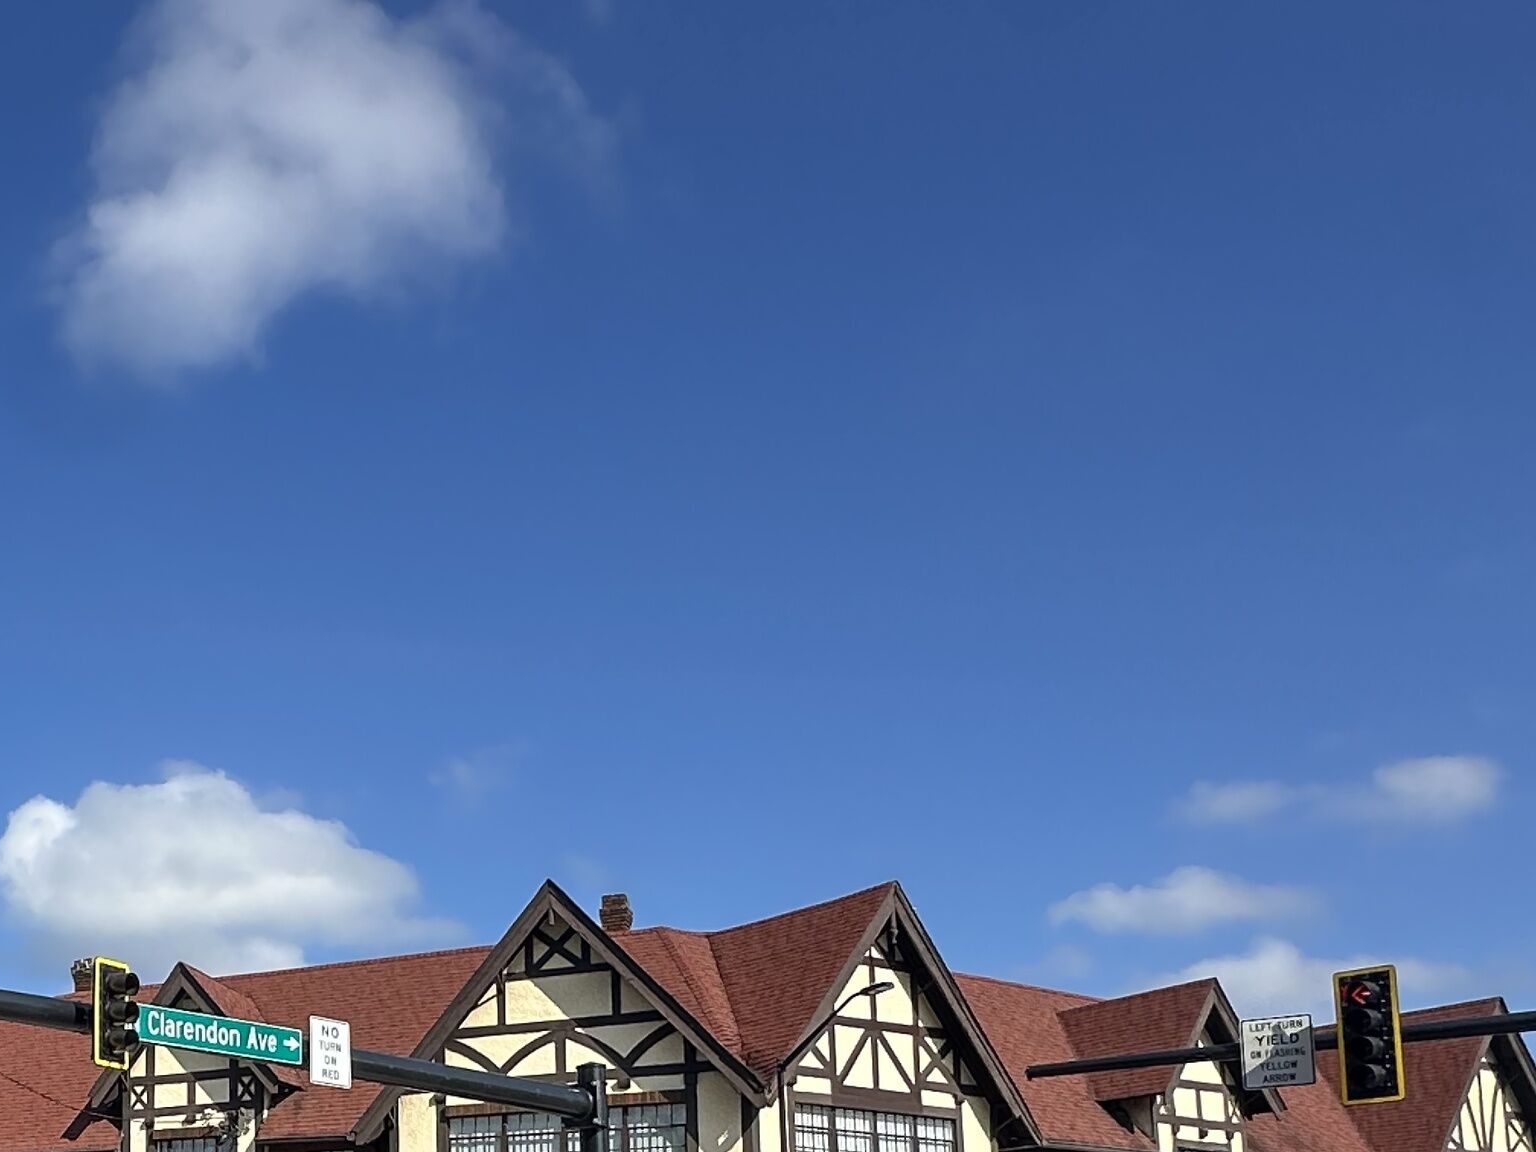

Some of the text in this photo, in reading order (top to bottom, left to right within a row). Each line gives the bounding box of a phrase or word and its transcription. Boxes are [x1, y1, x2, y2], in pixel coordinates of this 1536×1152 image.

[147, 1010, 278, 1053] Clarendon Ave
[321, 1024, 340, 1038] NO
[1248, 1019, 1303, 1033] LEFT TURN
[318, 1039, 342, 1053] TURN
[1254, 1032, 1300, 1047] YIELD
[324, 1054, 337, 1066] ON
[1249, 1046, 1306, 1060] ON FLASHING
[1260, 1060, 1298, 1071] YELLOW
[321, 1068, 340, 1081] RED
[1263, 1073, 1297, 1083] ARROW
